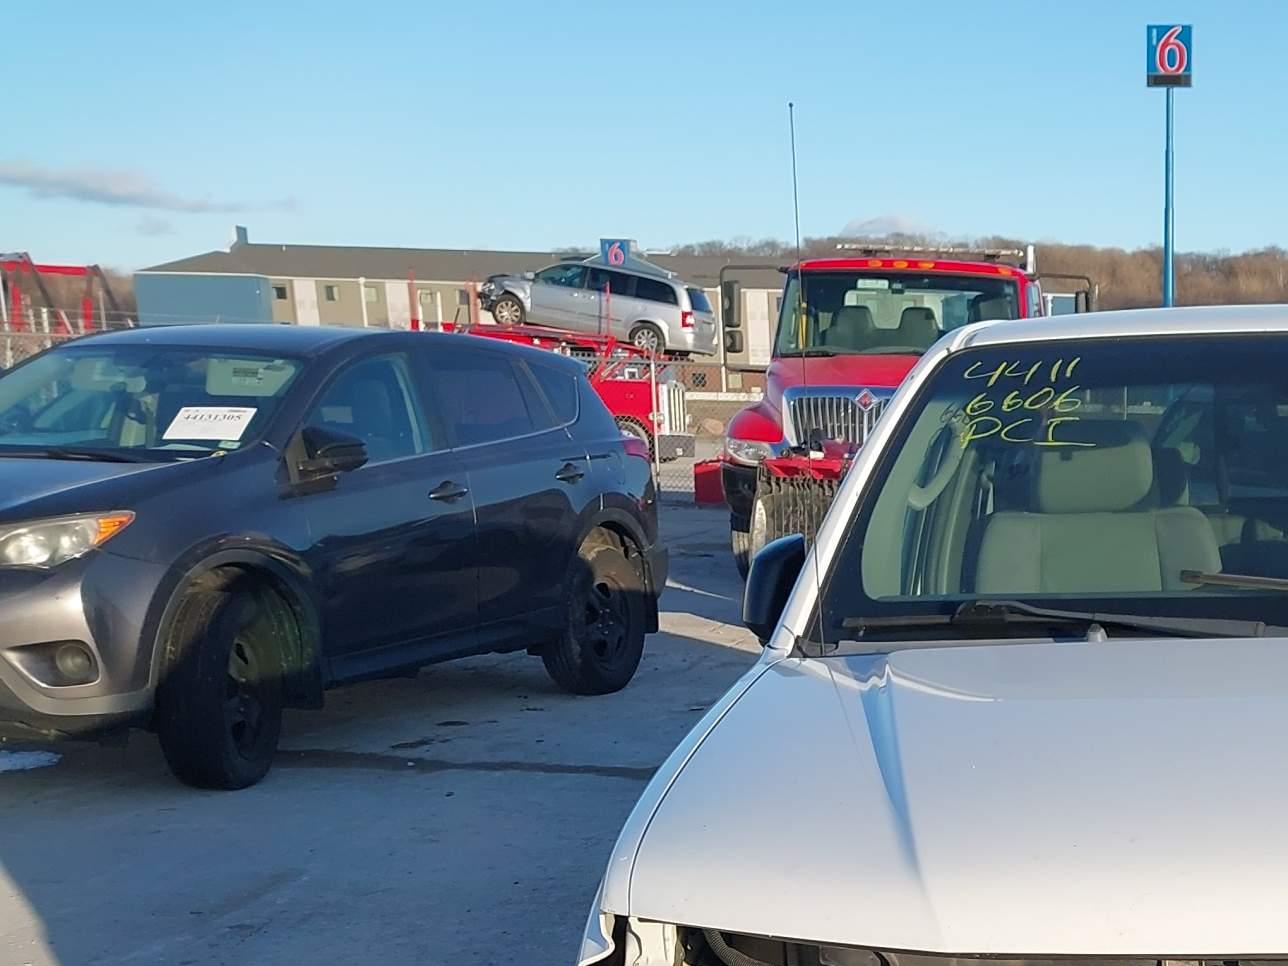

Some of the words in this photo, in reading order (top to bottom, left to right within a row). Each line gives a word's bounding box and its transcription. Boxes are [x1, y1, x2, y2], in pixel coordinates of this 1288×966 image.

[1155, 25, 1187, 75] 6
[607, 241, 624, 266] 6
[963, 357, 1081, 387] 4411
[966, 385, 1081, 415] 6606
